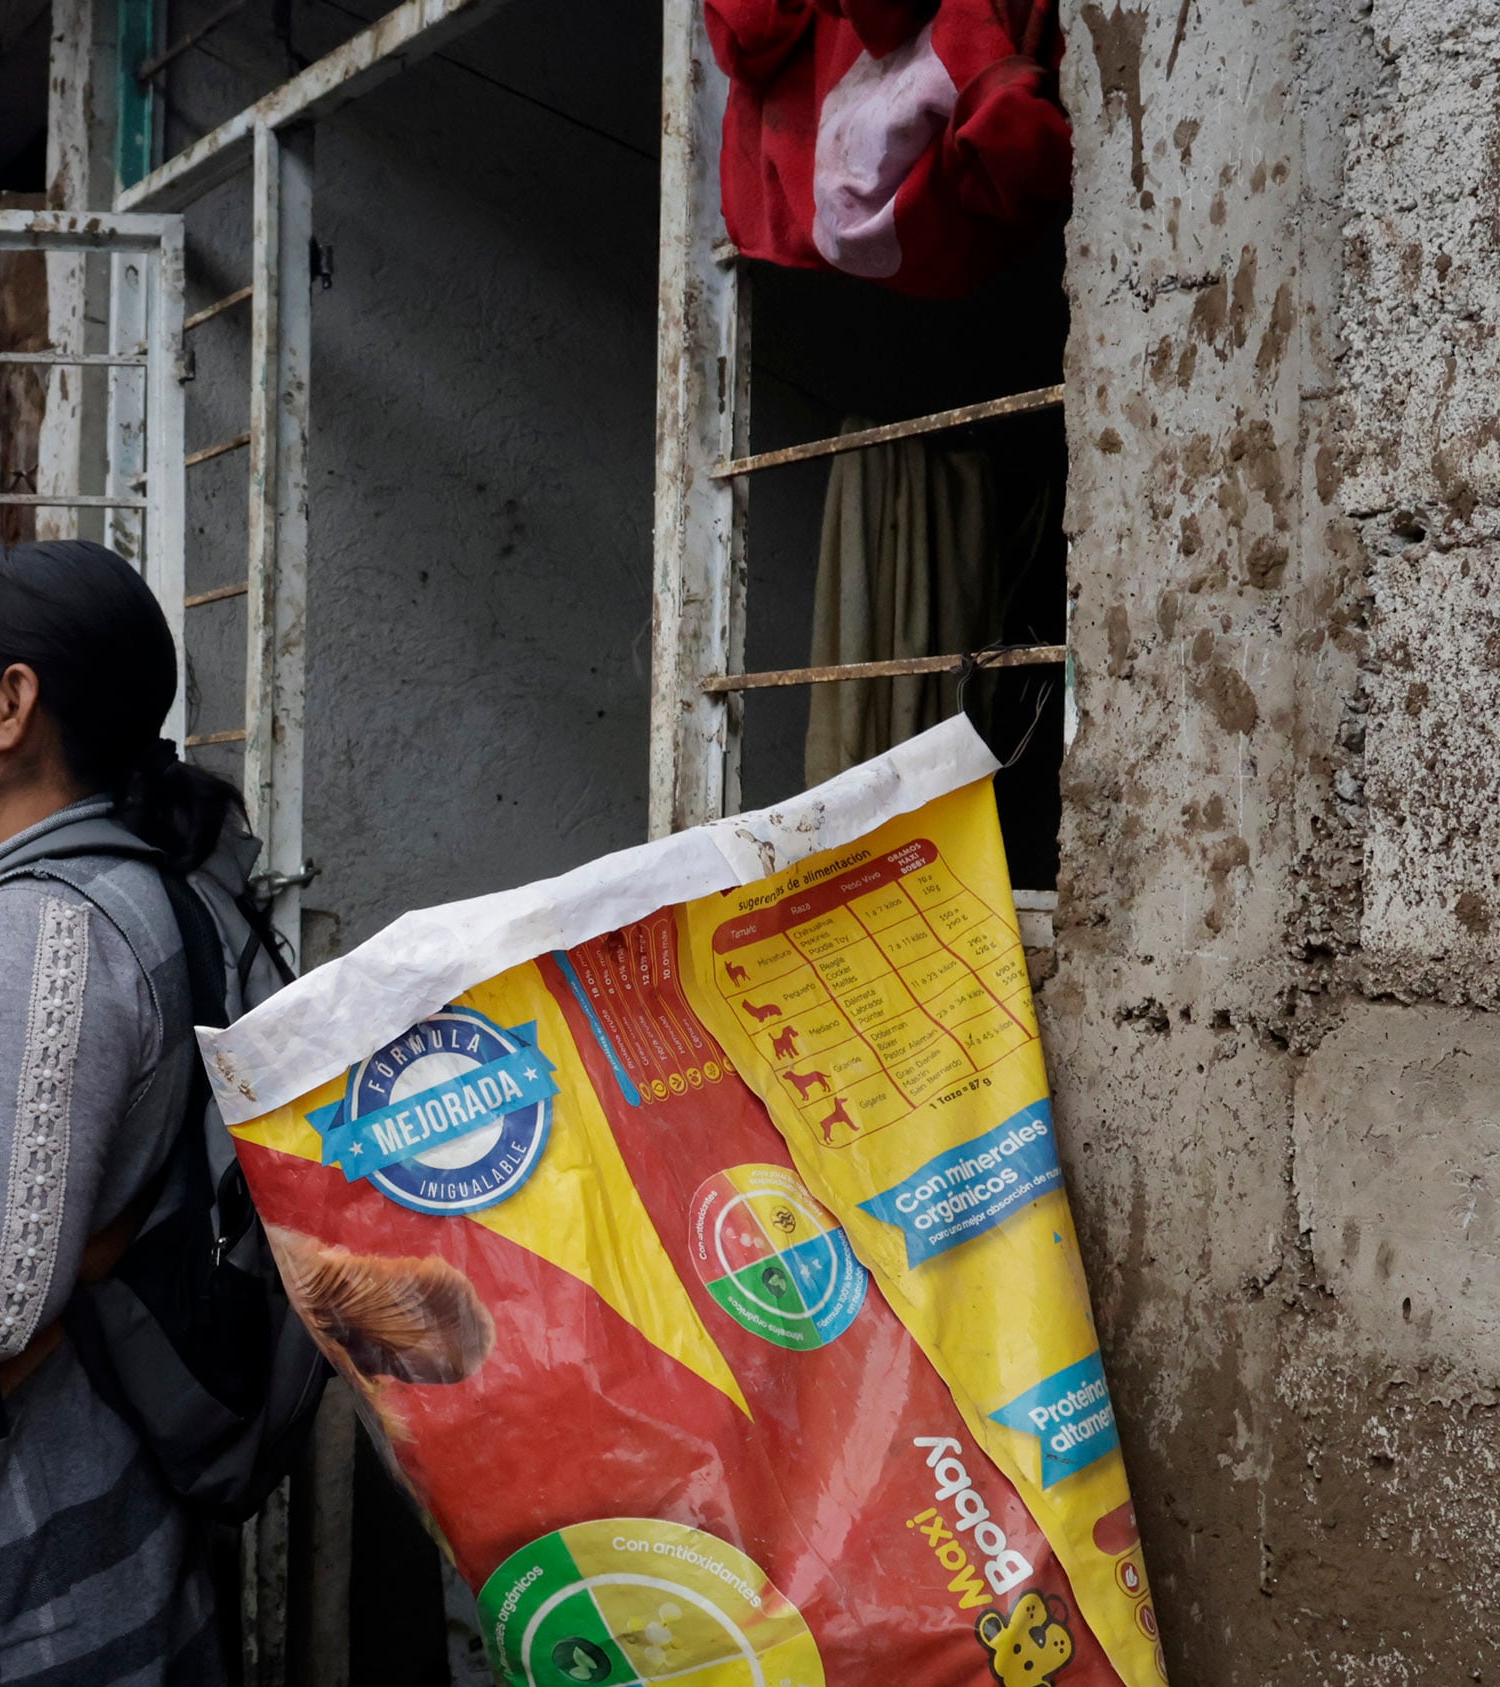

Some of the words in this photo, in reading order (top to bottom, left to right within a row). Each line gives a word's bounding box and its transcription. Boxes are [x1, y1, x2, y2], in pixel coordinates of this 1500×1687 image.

[887, 843, 922, 863] GRAMOS
[897, 852, 919, 867] MAXI
[900, 857, 928, 875] BOBBY
[787, 878, 800, 891] de
[790, 902, 811, 915] Raza
[840, 879, 862, 893] Peso
[862, 871, 881, 884] Vivo
[757, 949, 792, 968] Miniatura
[819, 955, 845, 971] Beagle
[835, 934, 850, 948] Toy
[368, 1029, 481, 1094] FÓRMULA
[883, 1047, 906, 1061] Pastor
[968, 1079, 981, 1091] 87
[983, 1076, 992, 1087] g
[372, 1070, 523, 1155] MEJORADA
[420, 1141, 527, 1198] INIGUALABLE
[895, 1174, 948, 1213] Con
[945, 1119, 1049, 1186] minerales
[914, 1167, 1019, 1230] orgánicos
[962, 1211, 986, 1232] mejor
[986, 1181, 1033, 1216] absorción
[1033, 1174, 1047, 1186] de
[699, 1238, 708, 1261] Con
[913, 1436, 1034, 1596] Bobby
[612, 1536, 649, 1553] Con
[653, 1538, 762, 1608] antioxidantes
[906, 1507, 994, 1610] Maxi
[499, 1565, 544, 1622] orgánicos
